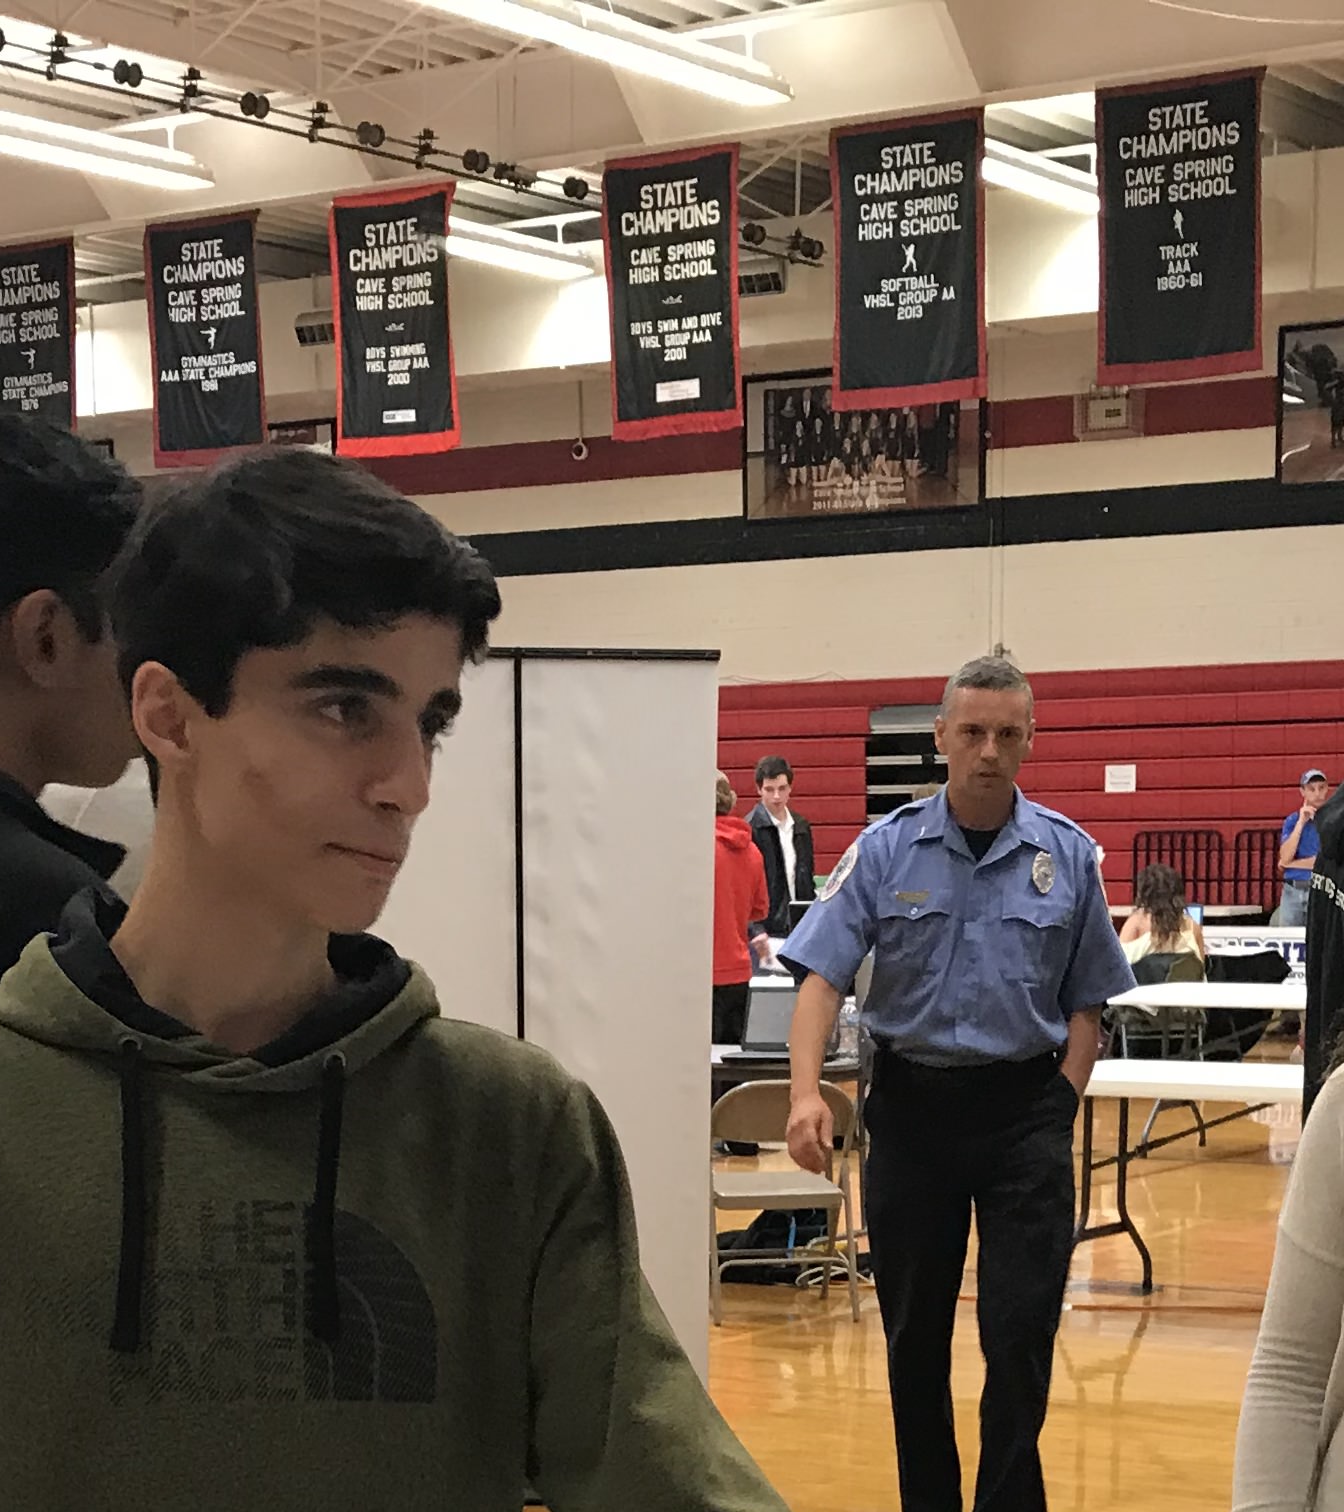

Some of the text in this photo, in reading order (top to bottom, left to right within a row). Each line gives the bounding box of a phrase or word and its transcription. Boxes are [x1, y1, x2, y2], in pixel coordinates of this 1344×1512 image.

[1148, 101, 1209, 131] STATE
[1119, 121, 1239, 160] CHAMPIONS
[881, 142, 935, 168] STATE
[854, 161, 963, 196] CHAMPIONS
[1125, 155, 1234, 187] CAVE SPRING
[640, 177, 698, 209] STATE
[1125, 177, 1236, 209] HIGH SCHOOL
[621, 200, 720, 236] CHAMPIONS
[860, 193, 958, 222] CAVE SPRING
[365, 217, 418, 247] STATE
[858, 212, 961, 241] HIGH SCHOOL
[181, 239, 223, 261] STATE
[349, 240, 438, 272] CHAMPIONS
[631, 239, 715, 265] CAVE SPRING
[1160, 242, 1199, 261] TRACK
[1, 264, 40, 285] STATE
[163, 256, 244, 284] CHAMPIONS
[629, 259, 717, 285] HIGH SCHOOL
[1167, 258, 1191, 274] AAA
[168, 283, 241, 306] CAVE SPRING
[357, 272, 431, 294] CAVE SPRING
[881, 274, 939, 293] SOFTBALL
[356, 290, 434, 310] HIGH SCHOOL
[863, 285, 955, 309] VHSL GROUP AA
[21, 307, 58, 324] SPRING
[169, 300, 245, 323] HIGH SCHOOL
[897, 305, 922, 320] 2013
[20, 324, 60, 341] SCHOOL
[631, 312, 722, 335] BOYS SWIM AND DIVE
[640, 329, 711, 349] VHSL GROUP AAA
[161, 361, 256, 382] AAA STATE CHAMPIONS
[181, 352, 234, 368] GYMNASTICS
[388, 359, 410, 371] GROUP
[413, 357, 429, 369] AAA
